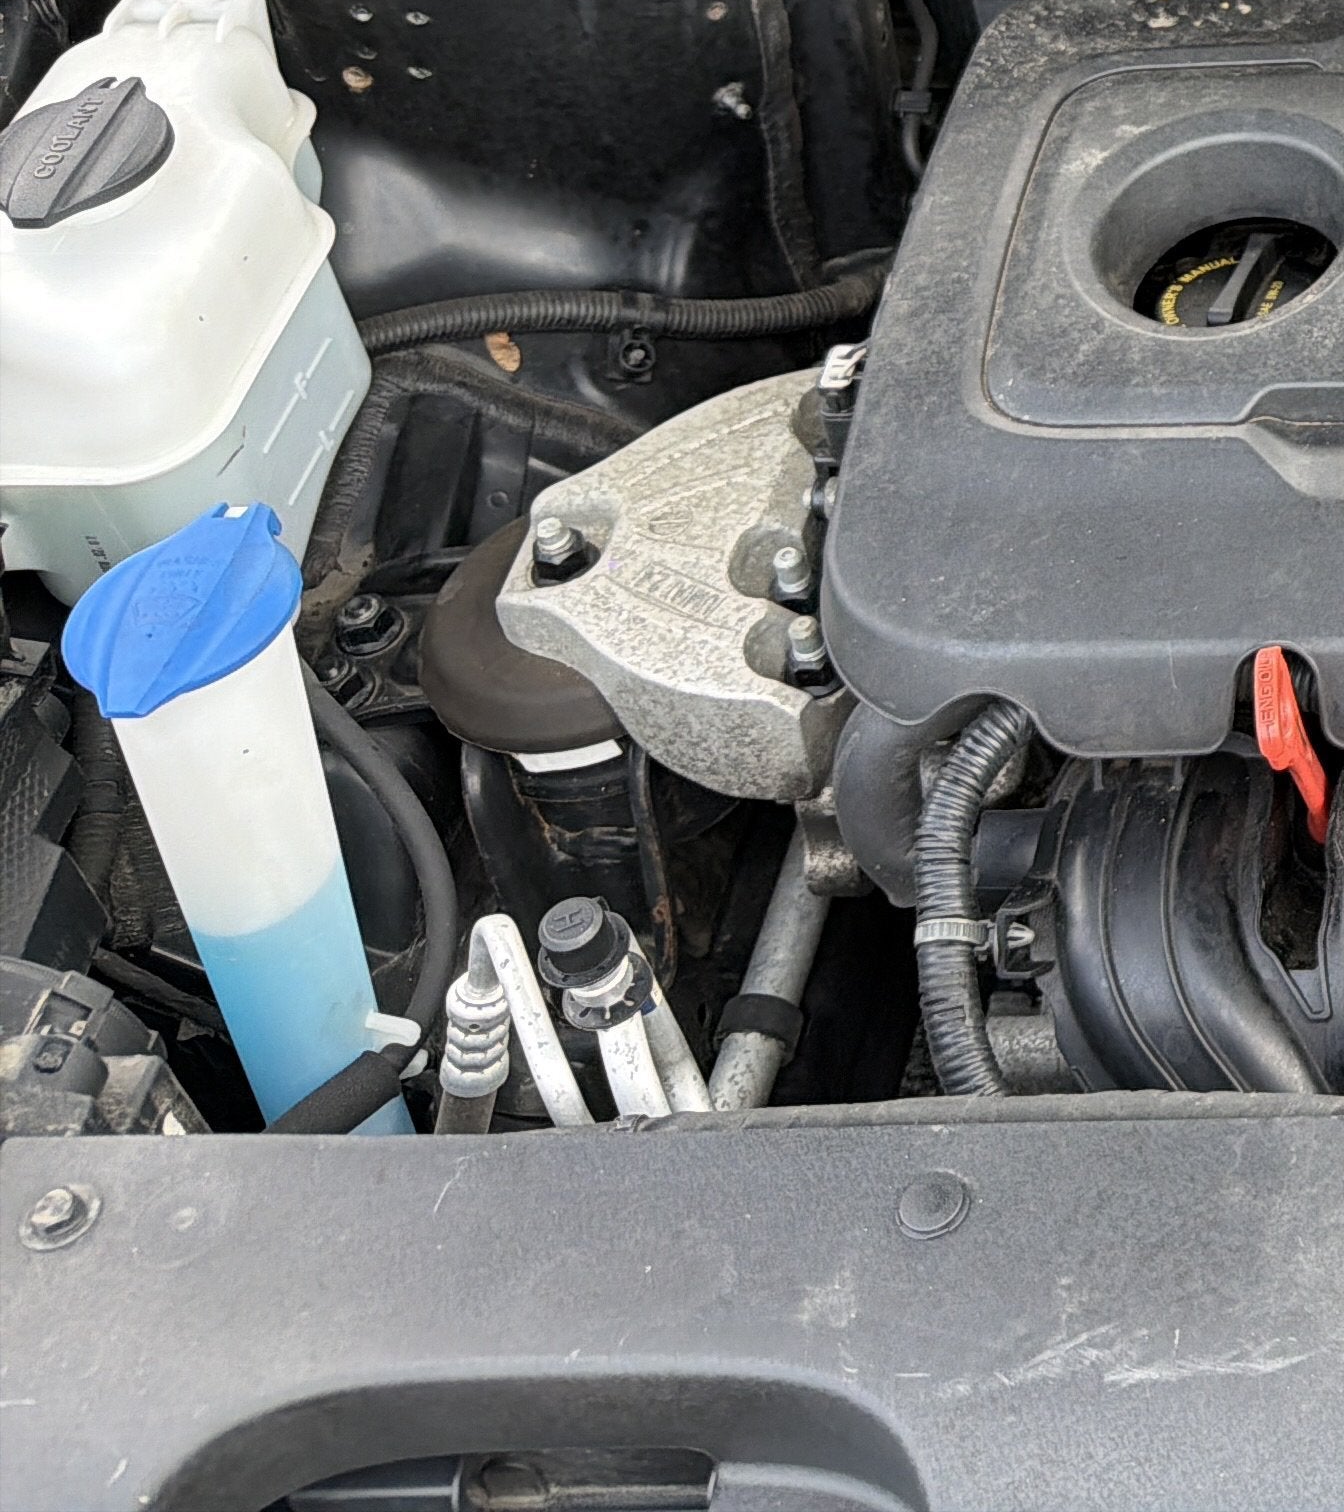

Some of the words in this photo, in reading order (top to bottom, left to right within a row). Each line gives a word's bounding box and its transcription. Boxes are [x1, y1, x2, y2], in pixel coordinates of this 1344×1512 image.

[33, 97, 104, 180] COOLANT
[1257, 655, 1274, 682] OIL
[1258, 683, 1276, 724] ENG
